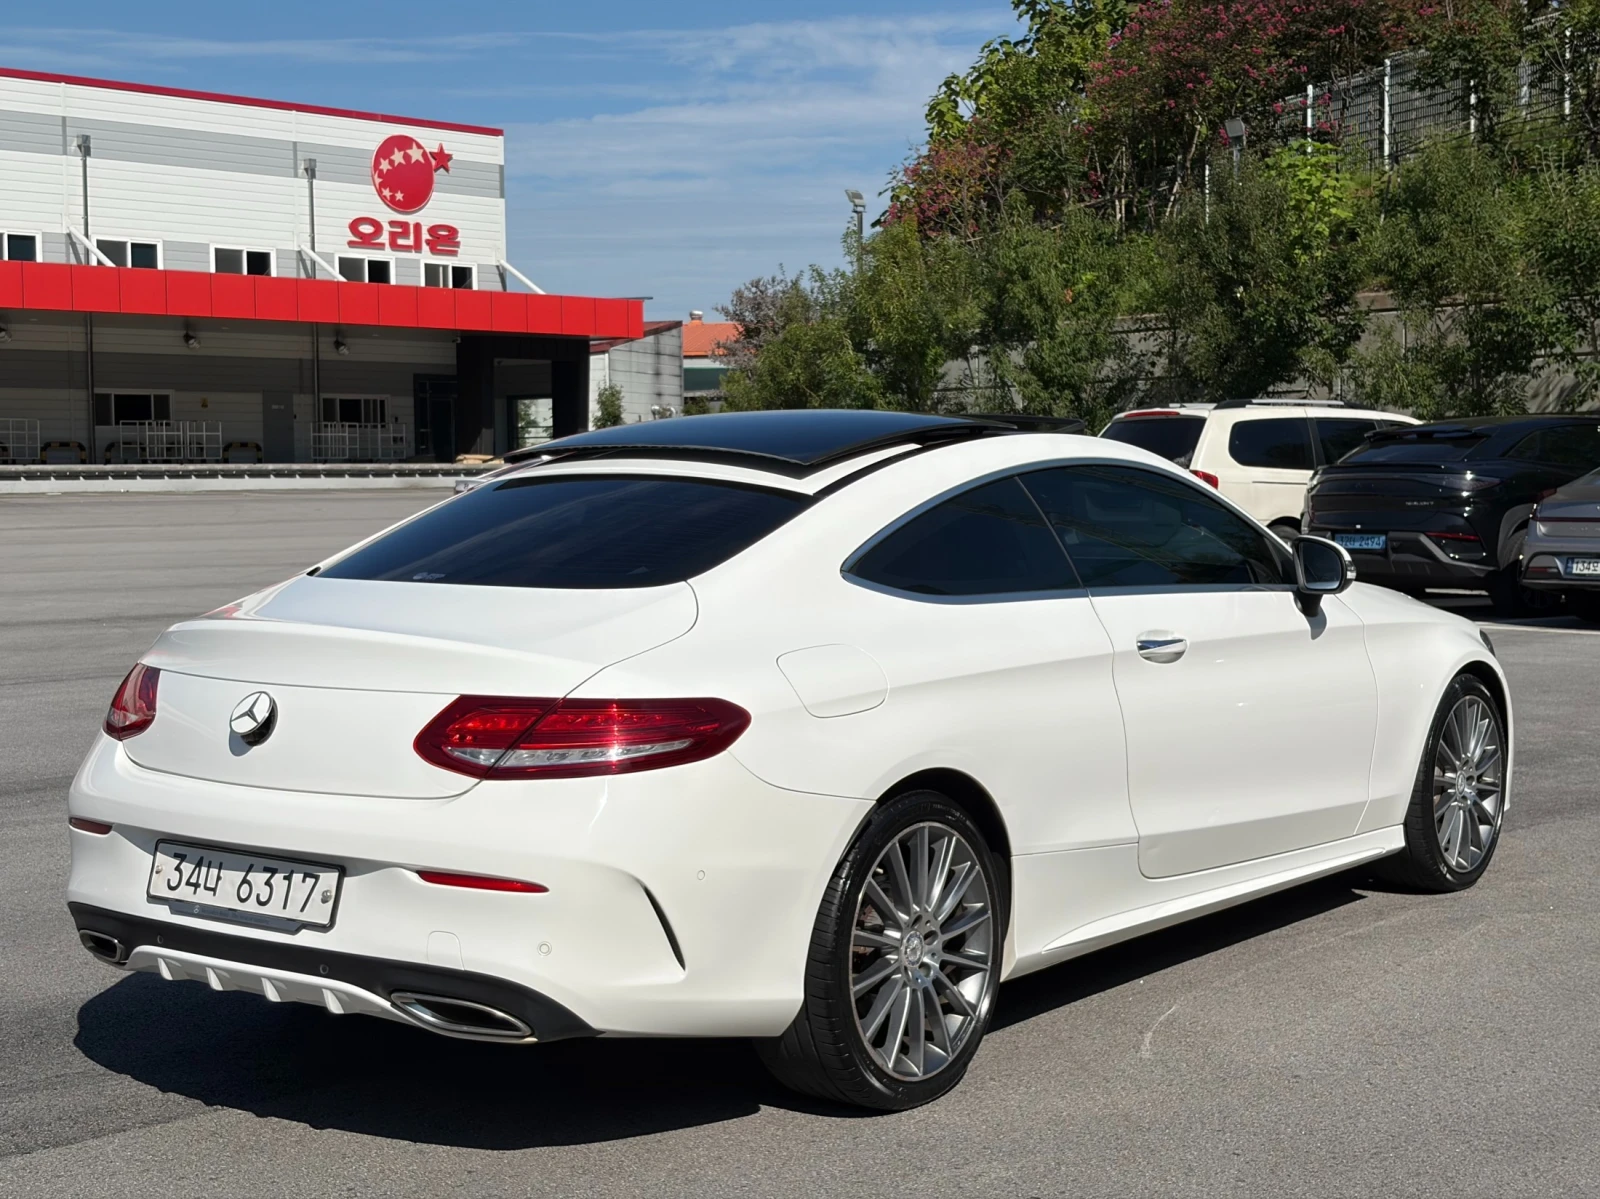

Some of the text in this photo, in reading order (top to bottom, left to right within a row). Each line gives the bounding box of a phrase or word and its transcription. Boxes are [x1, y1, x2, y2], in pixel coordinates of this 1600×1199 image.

[347, 216, 461, 257] 오리온
[166, 852, 321, 913] 34너 6317
